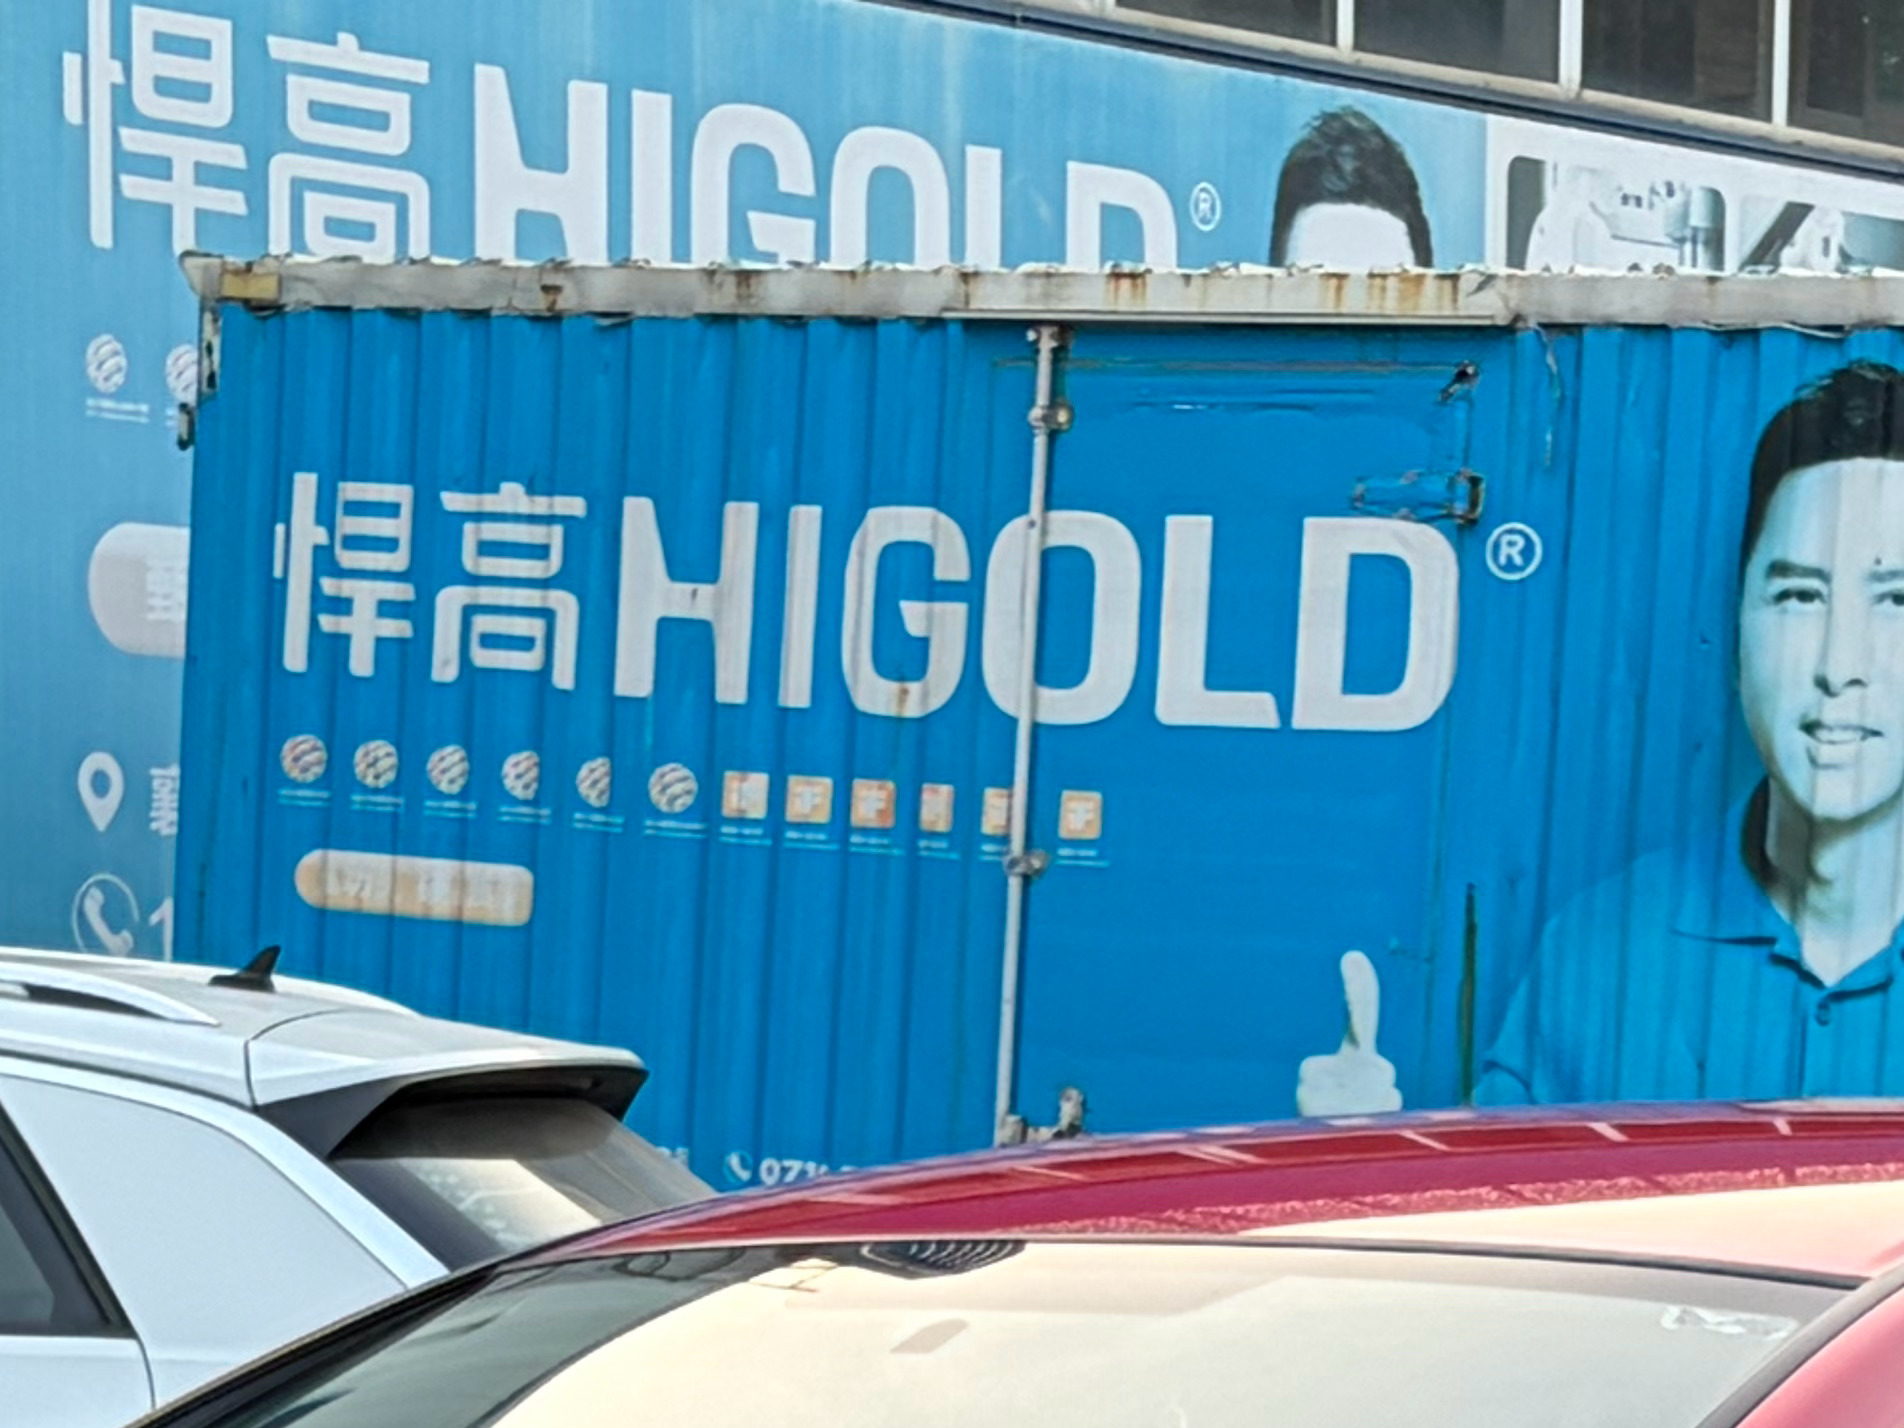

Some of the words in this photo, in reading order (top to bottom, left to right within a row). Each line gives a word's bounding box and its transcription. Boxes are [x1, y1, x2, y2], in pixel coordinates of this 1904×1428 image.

[62, 0, 431, 262] 悍高
[274, 472, 589, 692] 悍高
[614, 496, 1460, 733] HIGOLD
